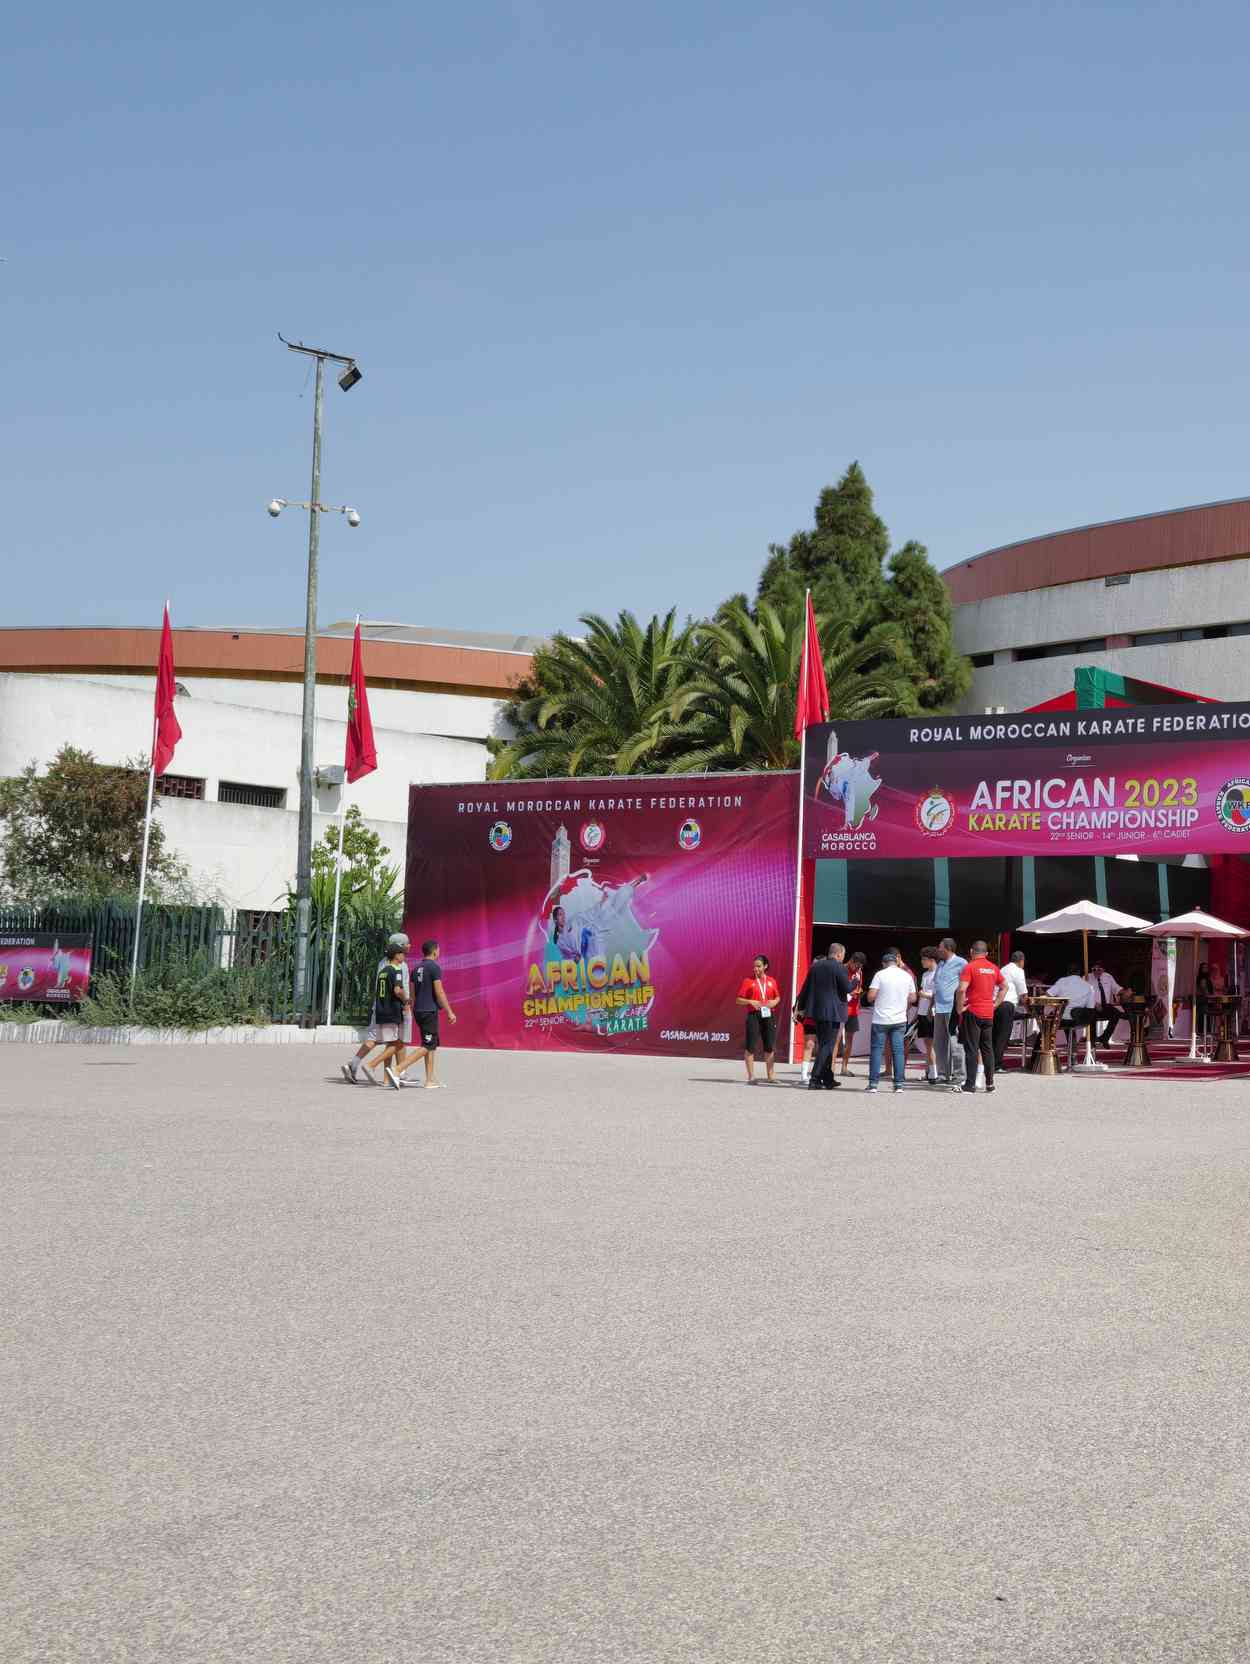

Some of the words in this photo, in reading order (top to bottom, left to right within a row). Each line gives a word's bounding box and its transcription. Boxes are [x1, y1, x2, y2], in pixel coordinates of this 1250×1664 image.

[910, 727, 963, 743] ROYAL
[970, 721, 1071, 741] MOROCCAN
[1077, 717, 1146, 736] KARATE
[969, 777, 1116, 810] AFRICAN
[1124, 776, 1199, 808] 2023
[458, 801, 499, 813] ROYAL
[506, 799, 581, 813] MOROCCAN
[589, 797, 642, 811] KARATE
[650, 796, 743, 809] FEDERATION
[968, 812, 1041, 832] KARATE
[1047, 807, 1199, 830] CHAMPIONSHIP
[822, 832, 876, 842] CASABLANCA
[1066, 832, 1094, 840] SENIOR
[1116, 831, 1145, 840] JUNIOR
[1164, 830, 1190, 838] CADET
[821, 841, 877, 850] MOROCCO
[527, 951, 651, 995] AFRICAN
[523, 986, 656, 1017] CHAMPIONSHIP
[607, 1017, 648, 1033] KARATE
[660, 1030, 709, 1041] CASABLANCA
[710, 1032, 730, 1042] 2023
